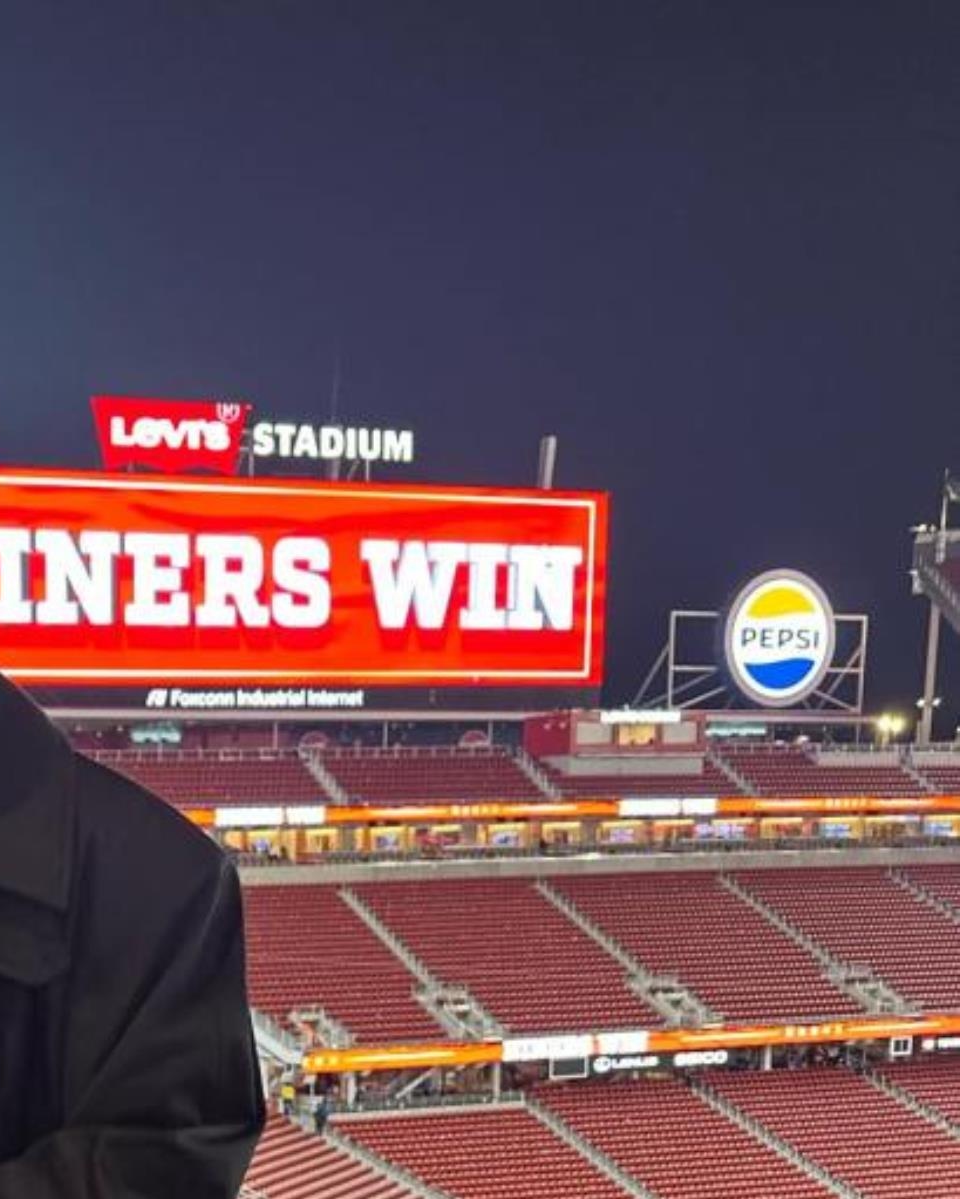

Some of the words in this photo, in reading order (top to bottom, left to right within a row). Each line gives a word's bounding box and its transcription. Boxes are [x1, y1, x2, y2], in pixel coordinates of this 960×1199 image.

[253, 421, 414, 462] STADIUM
[360, 538, 583, 631] WIN
[740, 627, 820, 650] PEPSI
